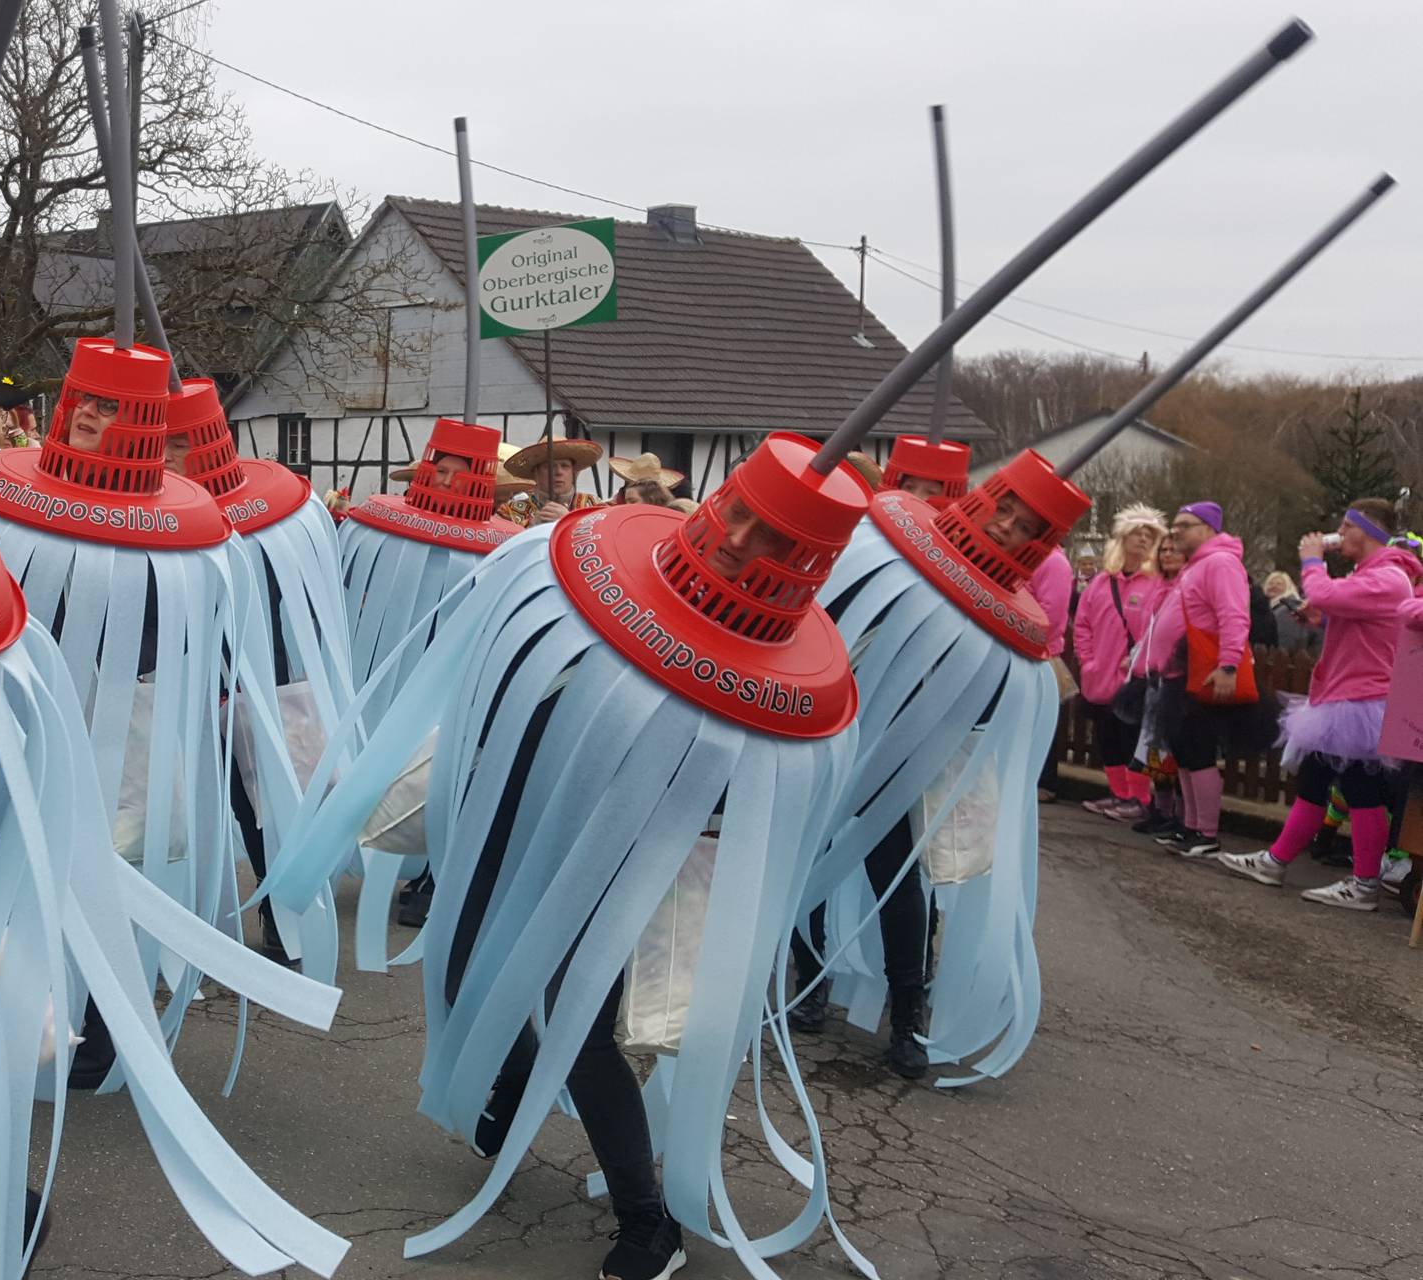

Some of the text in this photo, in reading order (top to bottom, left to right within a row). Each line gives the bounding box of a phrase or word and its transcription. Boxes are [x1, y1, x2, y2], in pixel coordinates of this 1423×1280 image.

[511, 246, 578, 268] Original
[483, 263, 610, 292] Oberbergische
[490, 284, 604, 313] Gurktaler
